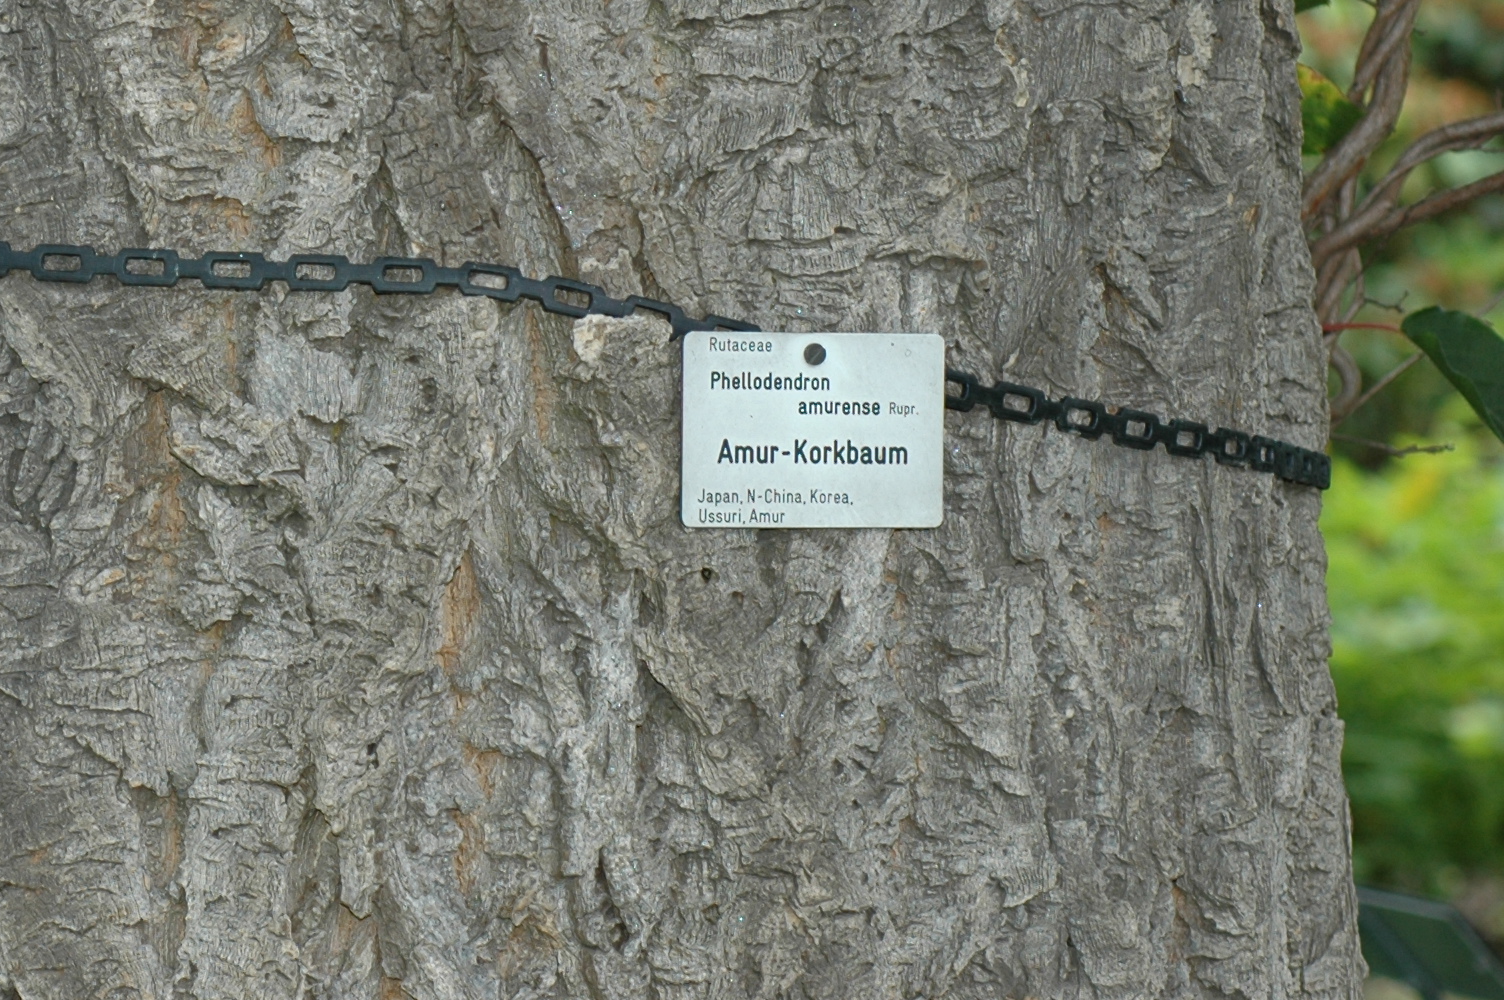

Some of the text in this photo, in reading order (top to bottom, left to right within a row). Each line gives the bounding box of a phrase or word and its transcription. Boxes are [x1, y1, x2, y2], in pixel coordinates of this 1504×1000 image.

[709, 337, 773, 352] Rutaceae
[710, 371, 830, 391] Phellodendron
[798, 401, 920, 418] amurense Rupr.
[717, 438, 908, 465] Amur-Korkbaum
[697, 489, 854, 506] Japan, N-China, Korea,
[698, 509, 786, 526] Ussuri, Amur
